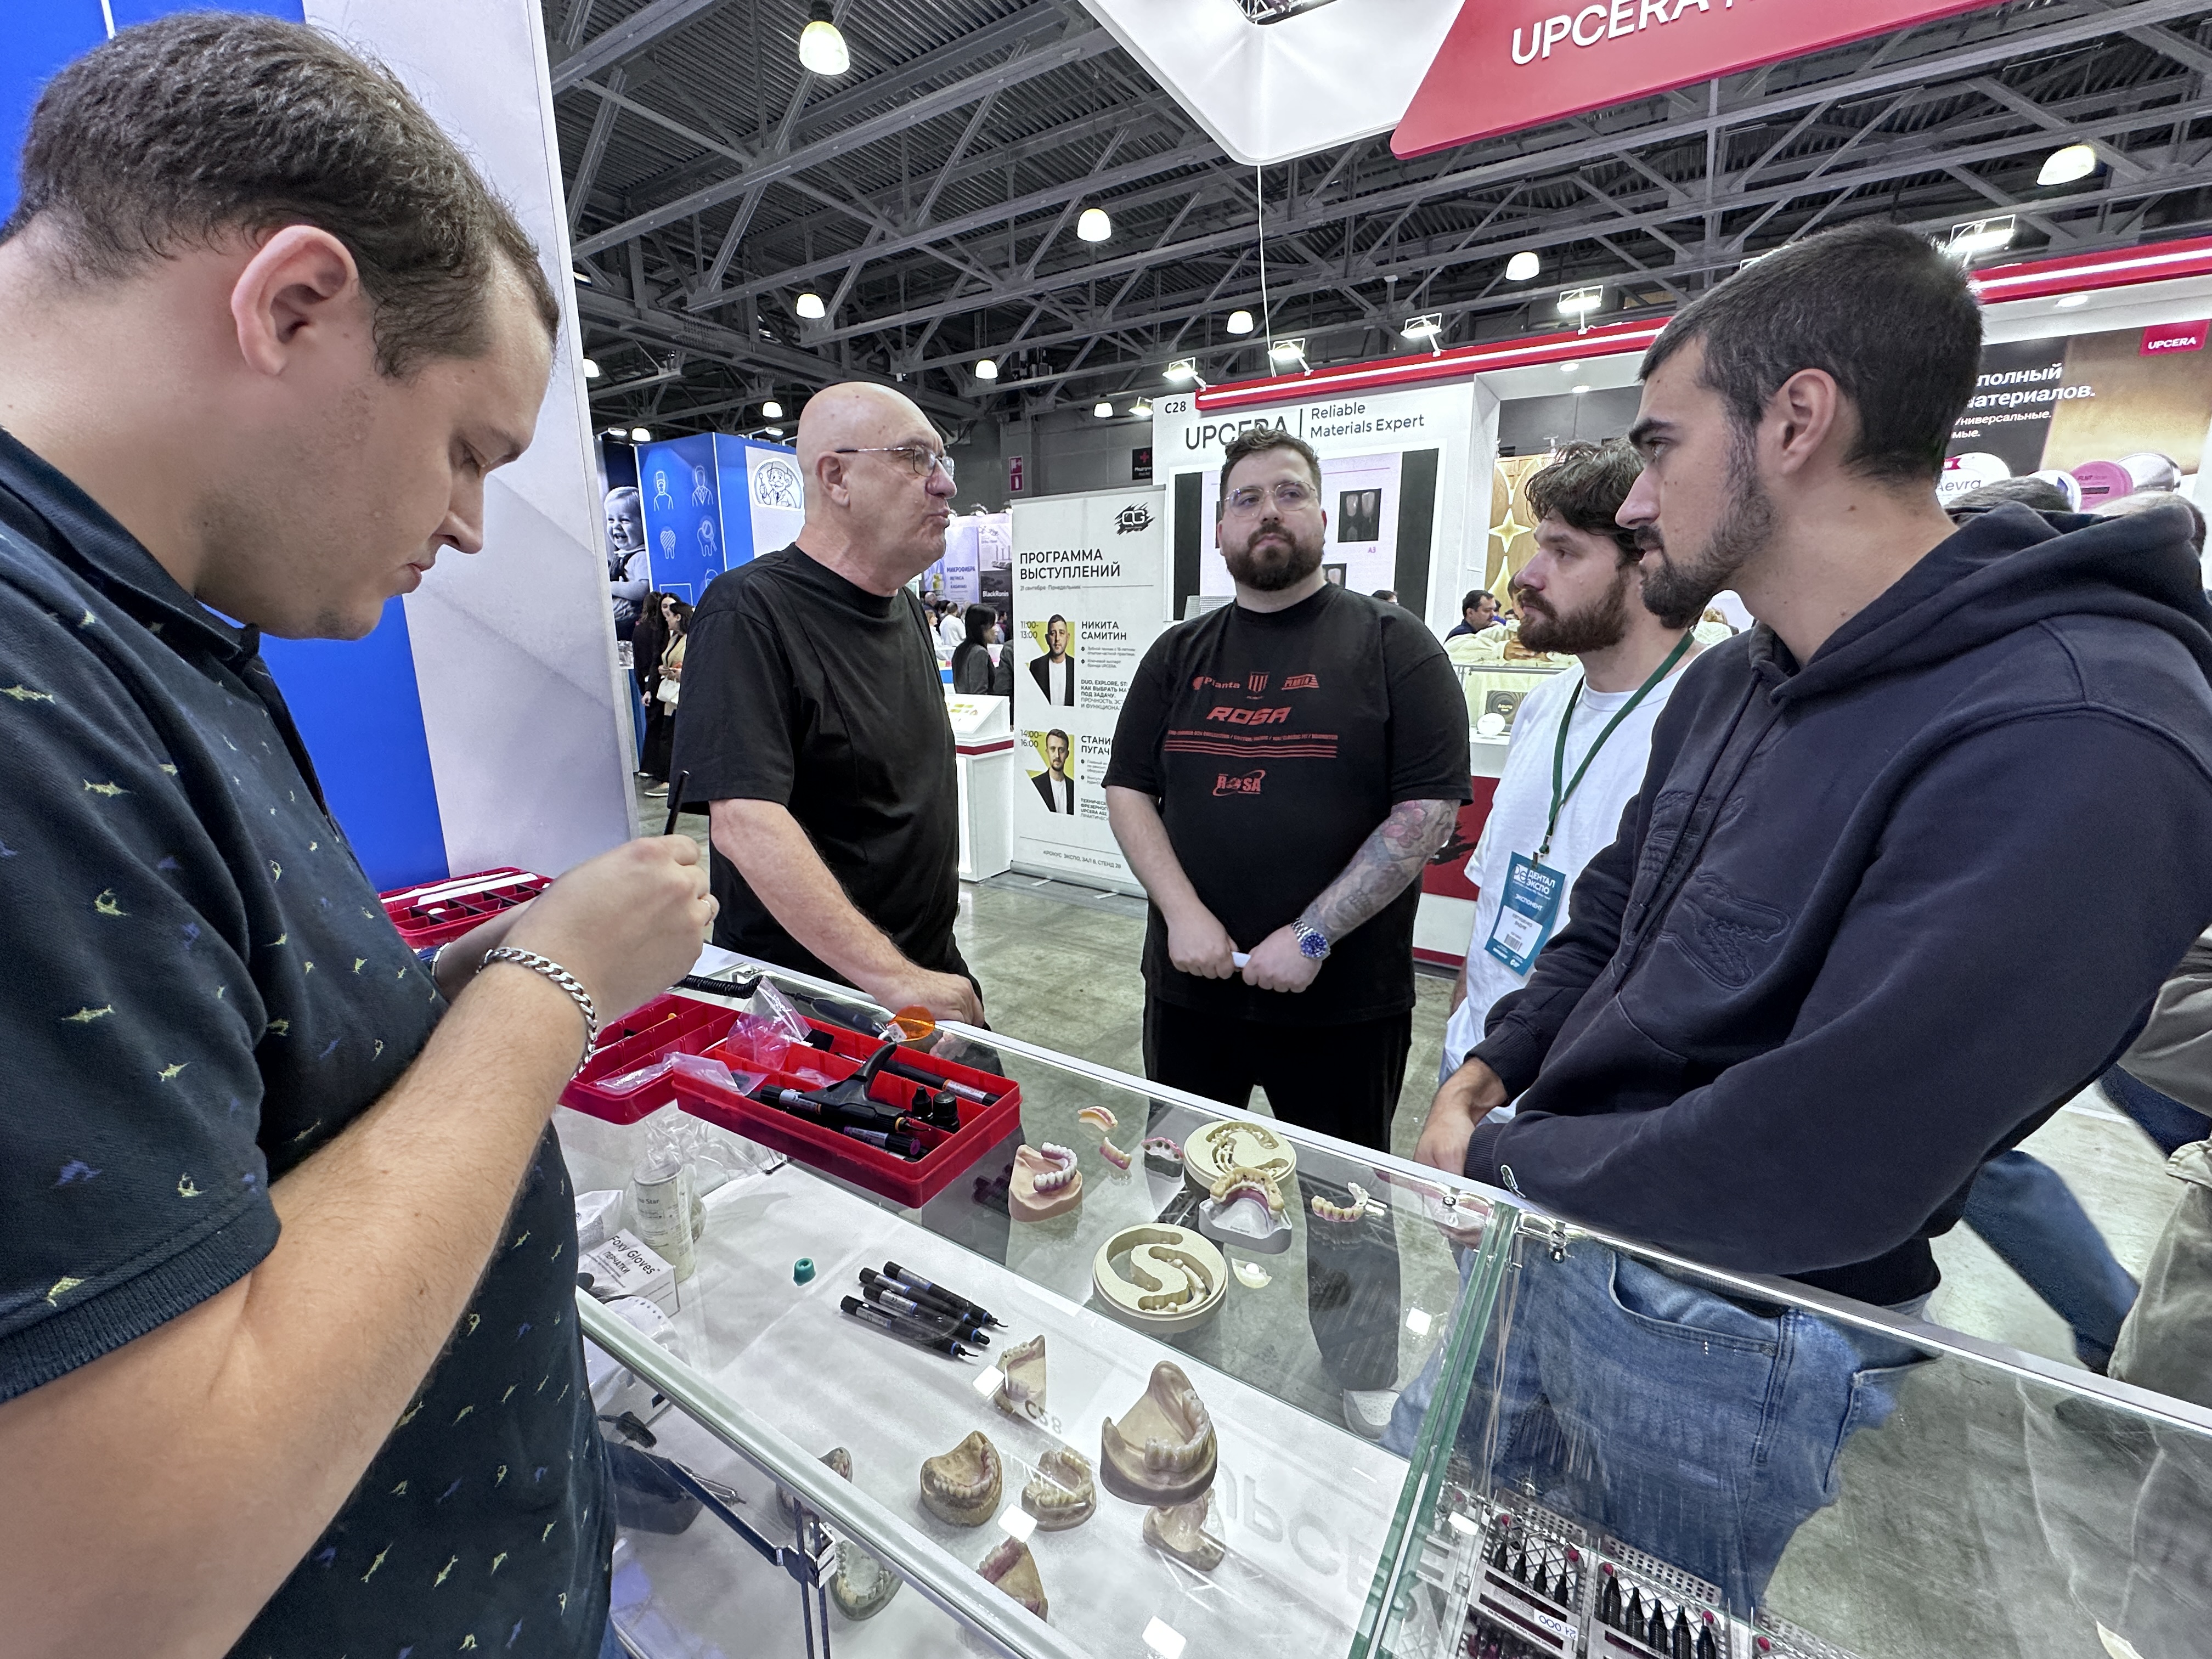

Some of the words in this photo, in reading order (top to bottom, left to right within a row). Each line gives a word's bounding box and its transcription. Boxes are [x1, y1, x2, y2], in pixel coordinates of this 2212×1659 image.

[2148, 337, 2197, 350] UPCERA
[1976, 362, 2063, 387] полный
[1165, 401, 1186, 414] C28
[1311, 402, 1365, 420] Reliable
[1311, 420, 1372, 439] Materials
[1376, 414, 1425, 432] Expert
[1951, 430, 1980, 438] мые.
[1020, 549, 1103, 565] ПРОГРАММА
[1020, 561, 1121, 580] ВЫСТУПЛЕНИЙ
[1081, 621, 1119, 629] НИКИТА
[1020, 631, 1037, 639] 13:00
[1081, 631, 1127, 640] САМИТИН
[1204, 676, 1240, 689] Planta
[1206, 706, 1292, 725] ROSA
[1020, 729, 1042, 738] 14:00-
[1081, 736, 1111, 745] СТАНИ
[1020, 739, 1039, 748] 16:00
[1081, 746, 1110, 755] ПУГАЧ
[1527, 870, 1556, 888] ДЕНТАЛ
[1526, 880, 1550, 895] ЭКСПО
[1515, 894, 1543, 912] ЭКСПОНЕНТ
[608, 1235, 630, 1252] Foxy
[627, 1250, 656, 1275] Gloves
[603, 1251, 631, 1274] ПЕРЧАТКИ
